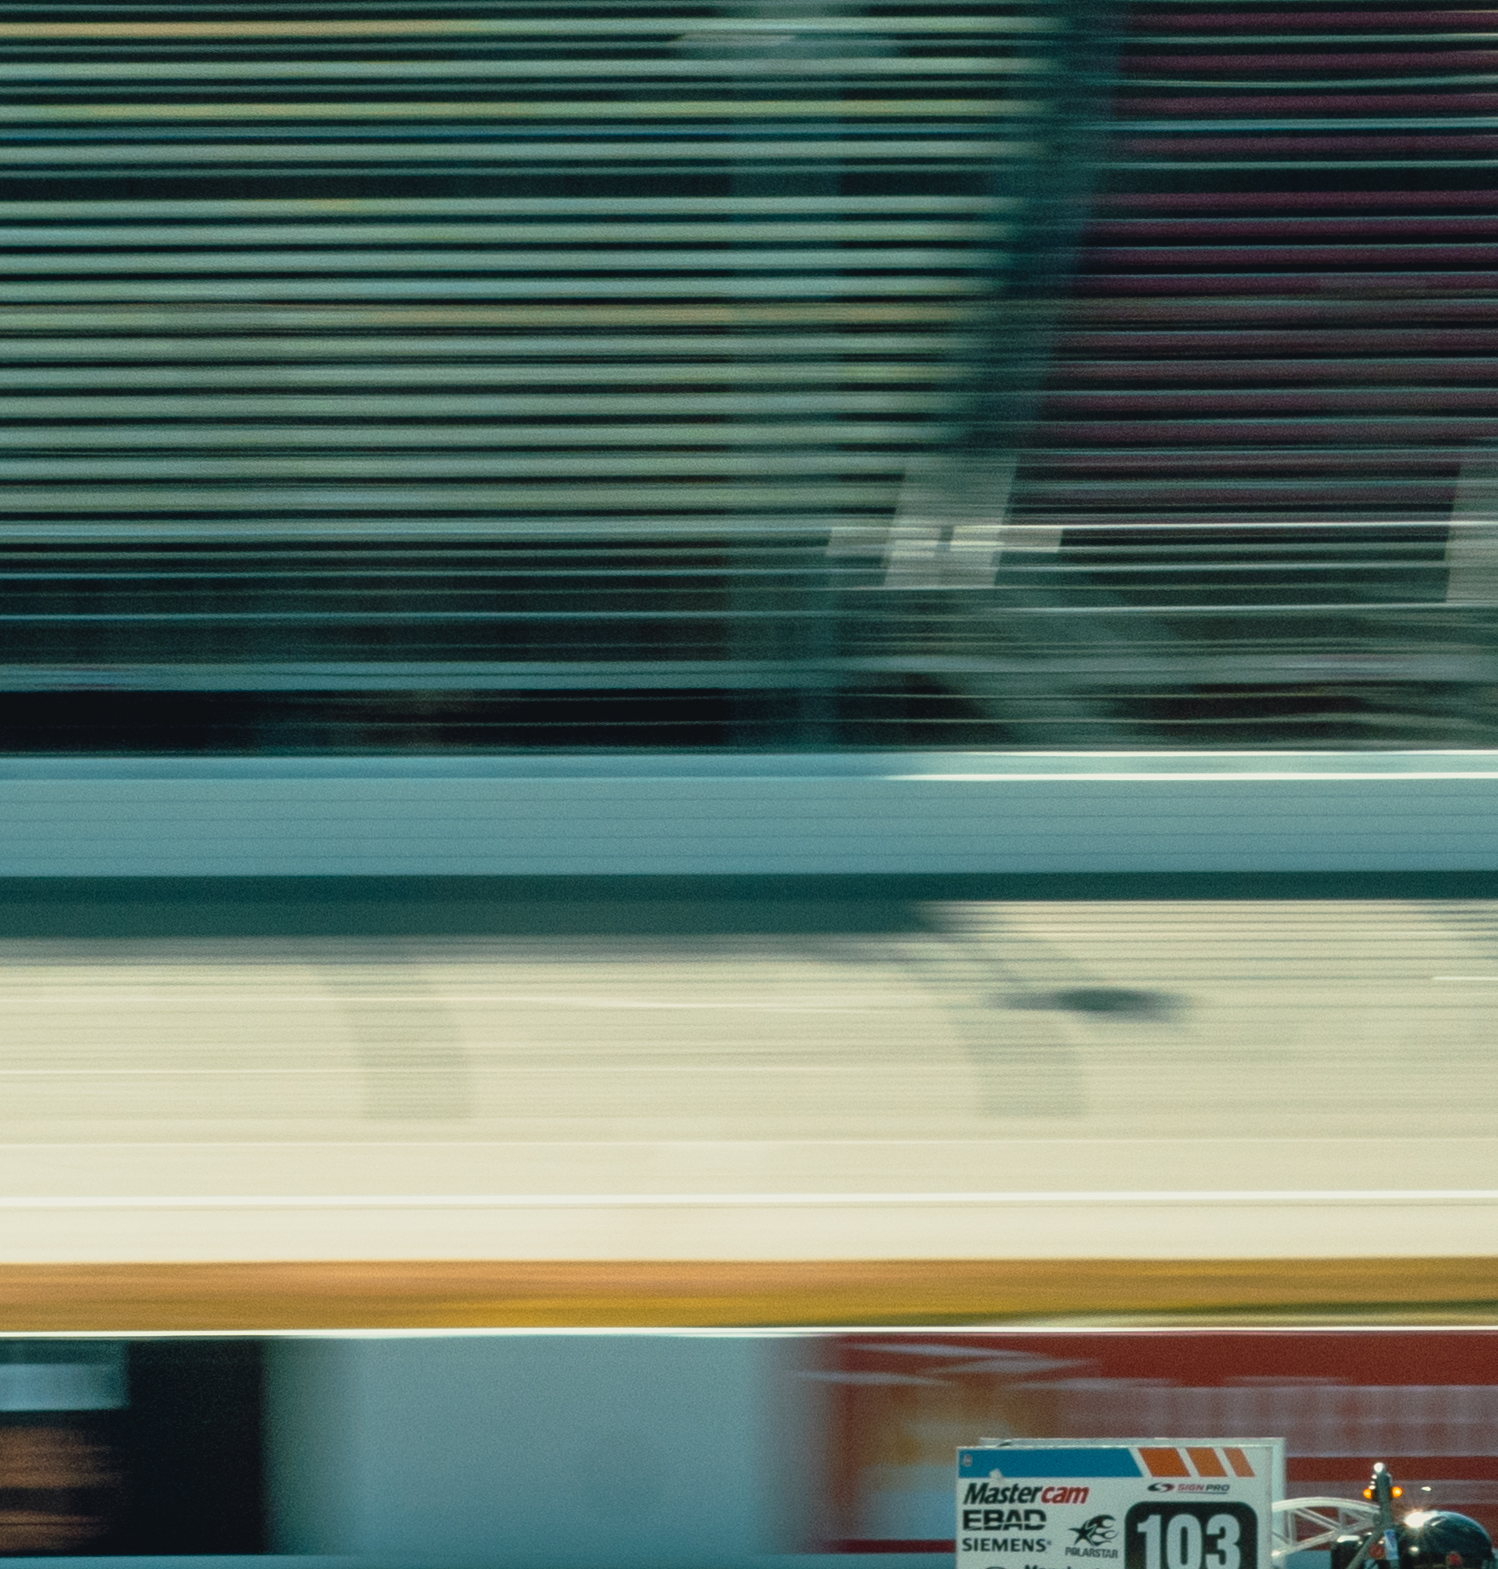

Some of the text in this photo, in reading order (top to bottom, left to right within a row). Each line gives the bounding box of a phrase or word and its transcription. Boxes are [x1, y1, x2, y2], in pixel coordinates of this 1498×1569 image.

[963, 1482, 1090, 1505] Mastercam
[1177, 1483, 1231, 1492] SIGN PRO
[962, 1508, 1047, 1531] EBAD
[962, 1537, 1047, 1552] SIEMENS
[1064, 1546, 1119, 1558] POLARSTAR
